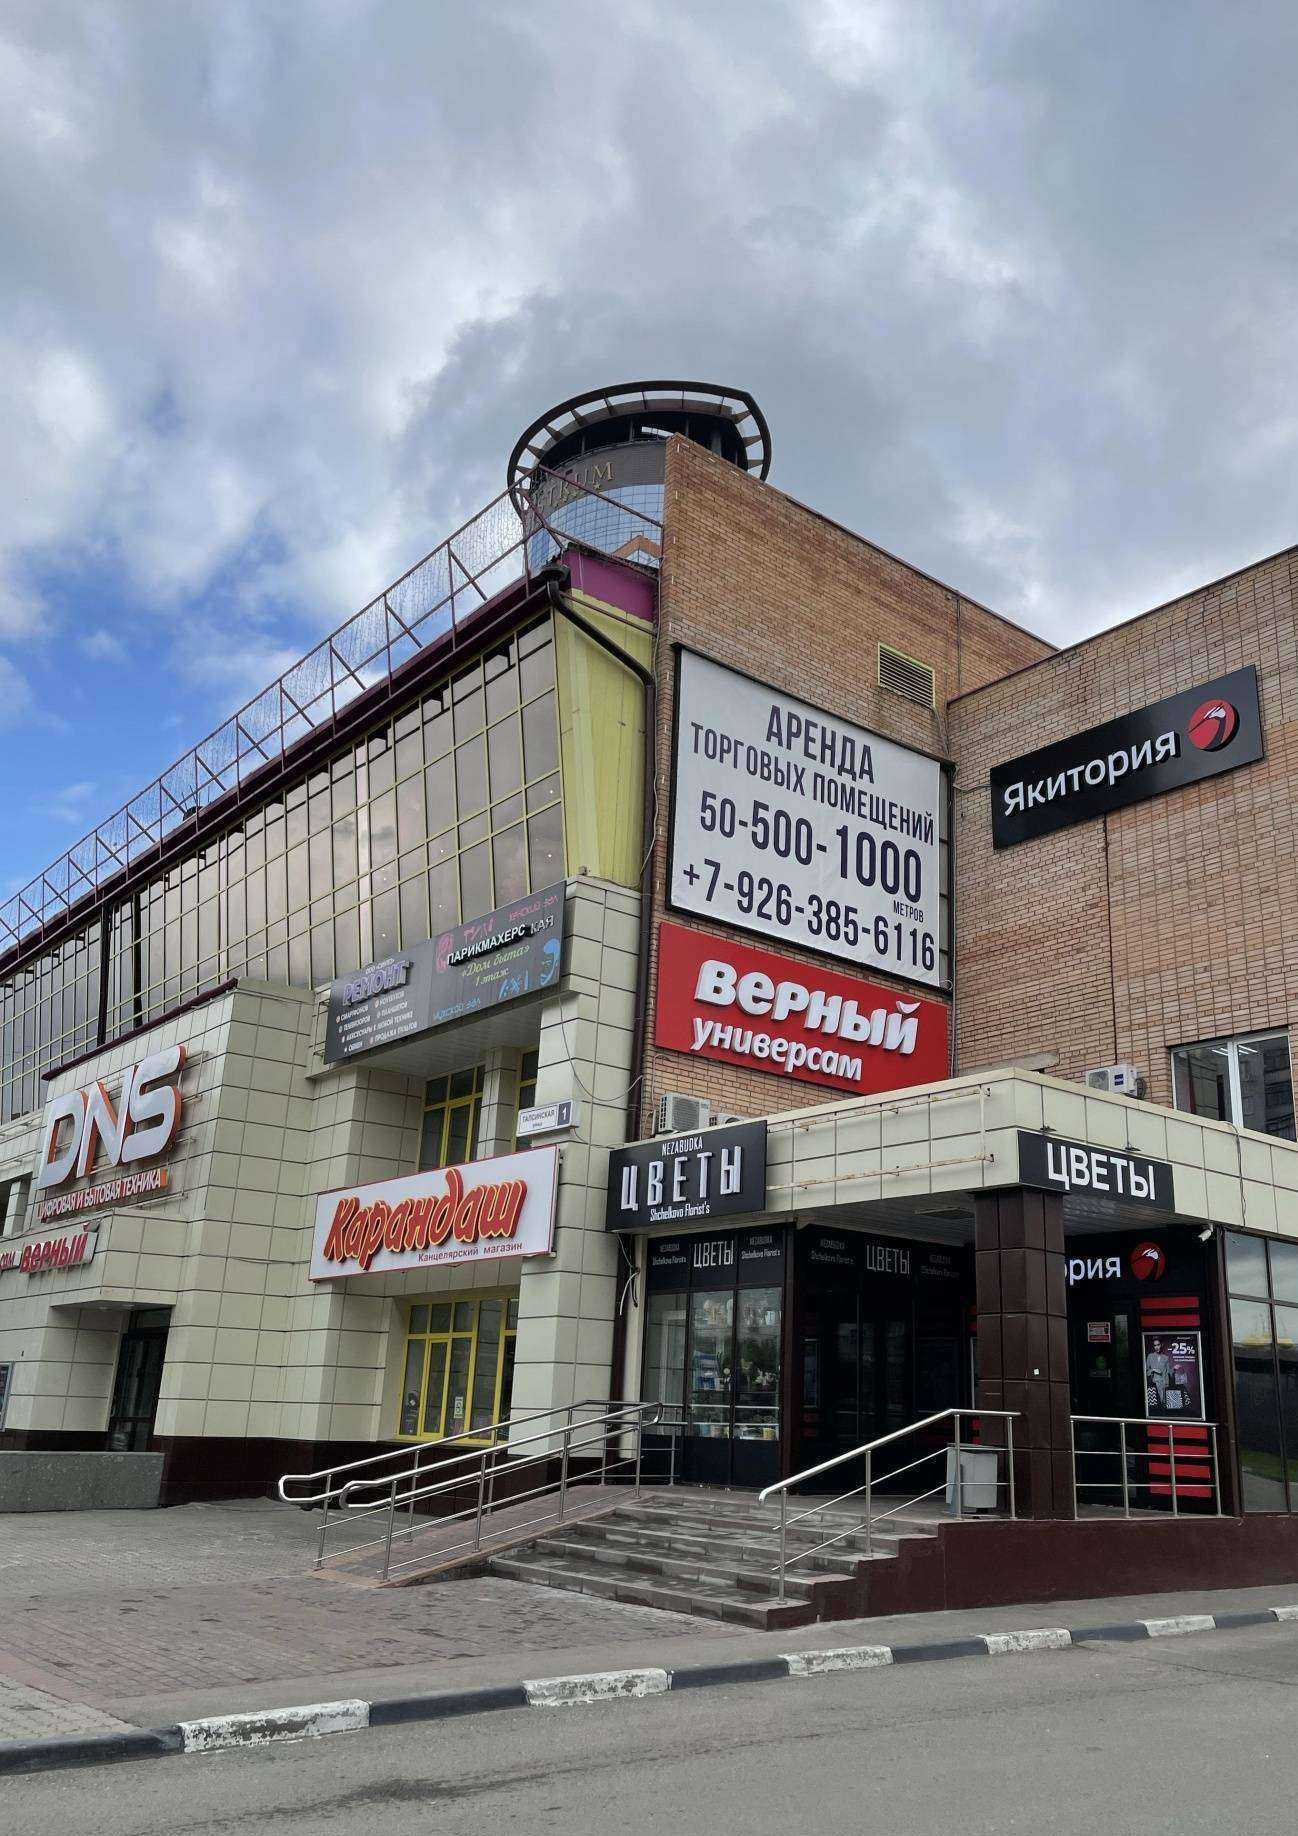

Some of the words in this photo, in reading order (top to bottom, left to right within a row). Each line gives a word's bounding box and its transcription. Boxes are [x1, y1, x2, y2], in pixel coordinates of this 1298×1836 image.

[766, 704, 875, 784] АРЕНДА
[691, 721, 806, 797] ТОРГОВЫХ
[813, 771, 934, 846] ПОМЕЩЕНИЙ
[1003, 731, 1176, 817] Якитория
[700, 790, 922, 903] 50-500-1000
[683, 858, 935, 971] +7-926-385-6116
[893, 900, 924, 923] МЕТРОВ
[342, 961, 410, 1006] РЕМОНТ
[690, 1017, 863, 1081] универсам
[36, 1044, 186, 1190] DNS
[562, 1106, 567, 1120] 1
[661, 1136, 703, 1156] NEZABUDKA
[1046, 1142, 1156, 1201] ЦВЕТЫ
[83, 1184, 121, 1208] БЫТОВАЯ
[122, 1169, 161, 1198] ТЕХНИКА
[620, 1145, 742, 1212] ЦВЕТЫ
[324, 1167, 528, 1271] Карандаш
[684, 1201, 710, 1217] Florist's
[418, 1247, 479, 1263] Канцелярский
[483, 1242, 523, 1255] магазин
[693, 1240, 734, 1268] ЦВЕТЫ
[866, 1244, 910, 1275] ЦВЕТЫ
[1168, 1342, 1196, 1355] -25%
